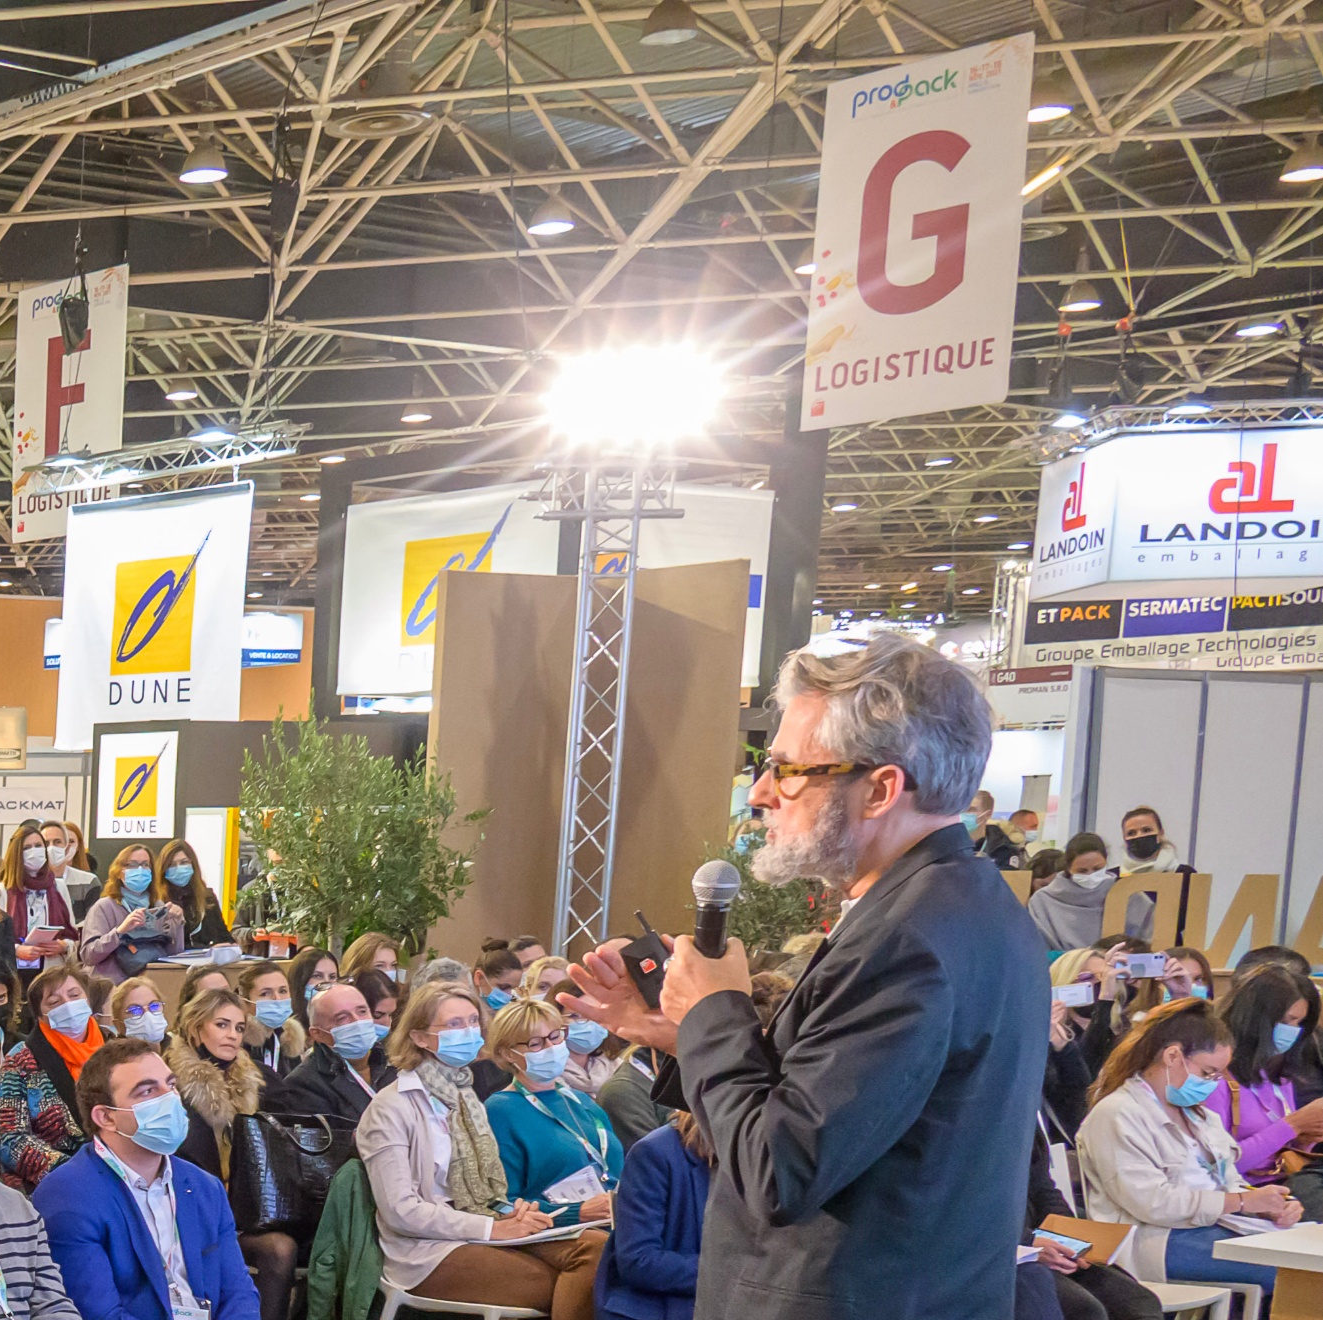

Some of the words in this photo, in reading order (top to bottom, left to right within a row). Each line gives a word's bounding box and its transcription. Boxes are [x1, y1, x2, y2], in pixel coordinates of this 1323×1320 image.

[856, 130, 971, 315] G
[815, 337, 995, 393] LOGISTIQUE
[45, 328, 91, 459] F
[1040, 528, 1105, 563] LANDOIN
[1129, 596, 1223, 617] SERMATEC
[1231, 588, 1323, 609] PACTISOU
[249, 652, 265, 660] VENTE
[272, 651, 299, 660] LOCATION
[1036, 647, 1094, 663] Groupe
[1101, 642, 1190, 659] Emballage
[1197, 632, 1317, 652] Technologies
[109, 678, 191, 706] DUNE
[997, 671, 1016, 683] G40
[113, 819, 157, 833] DUNE
